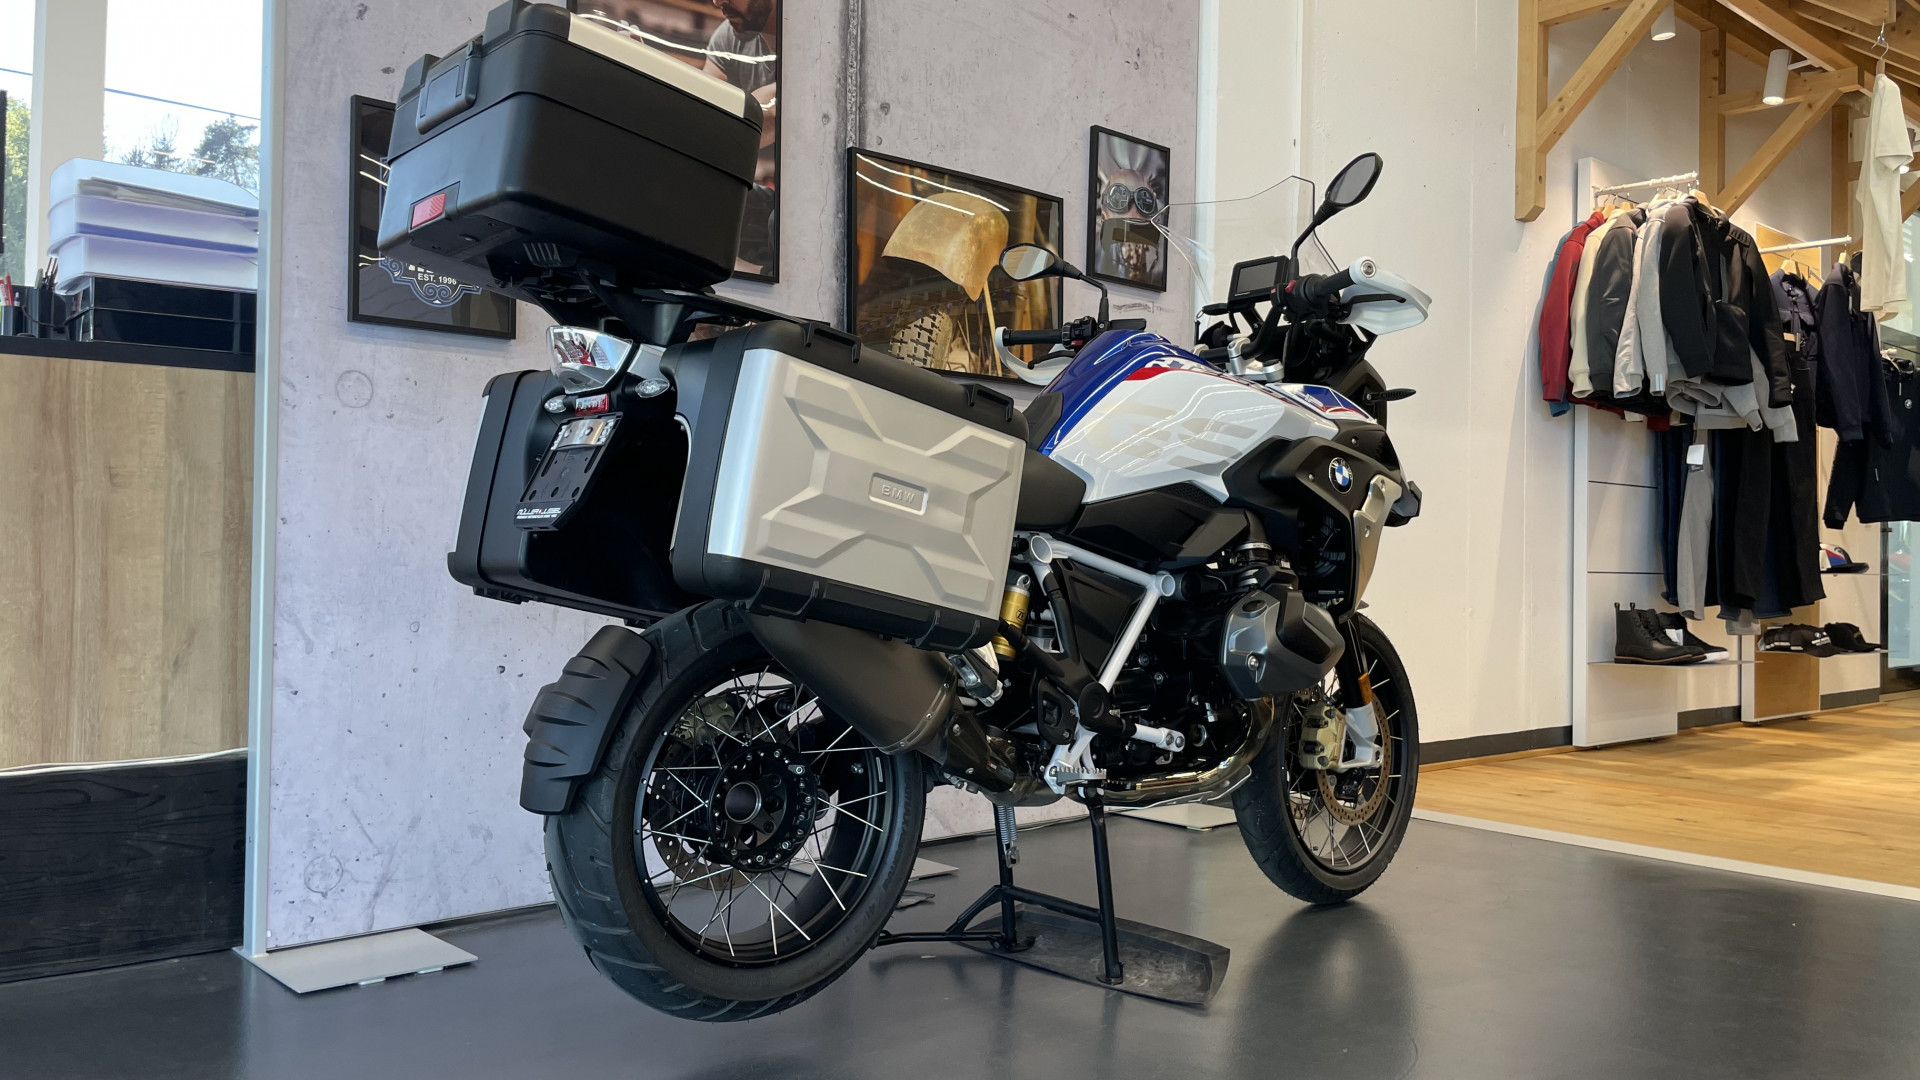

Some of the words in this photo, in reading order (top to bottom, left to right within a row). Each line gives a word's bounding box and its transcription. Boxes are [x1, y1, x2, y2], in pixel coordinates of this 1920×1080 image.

[418, 273, 436, 282] EST.
[438, 276, 457, 285] 1996
[881, 484, 916, 503] BMW
